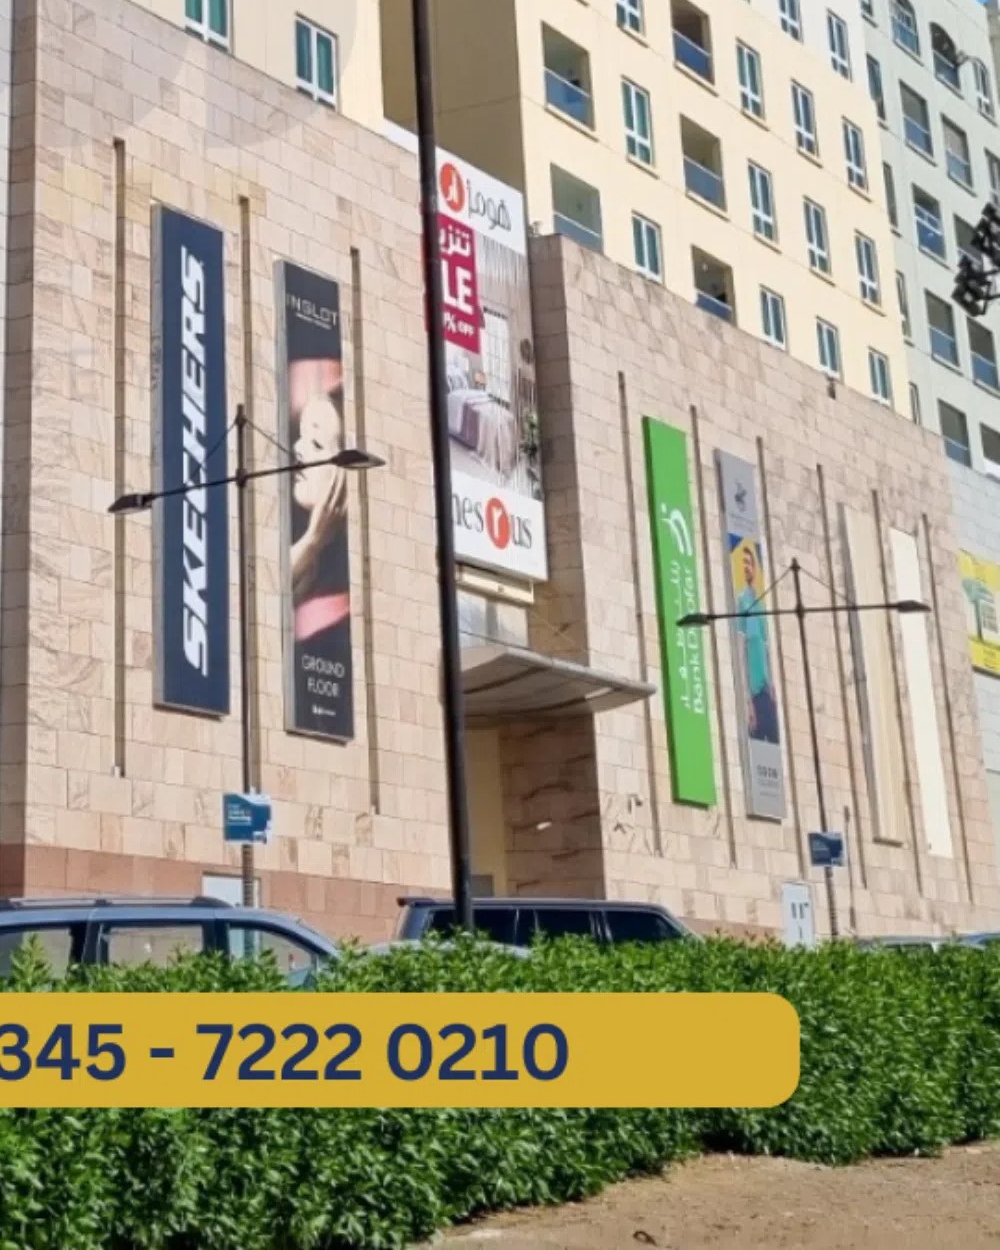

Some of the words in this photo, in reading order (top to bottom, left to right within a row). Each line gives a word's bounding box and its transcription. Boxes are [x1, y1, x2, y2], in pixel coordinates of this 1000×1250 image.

[441, 258, 474, 316] LE
[180, 245, 209, 677] SKECHERS
[302, 654, 345, 678] GROUND
